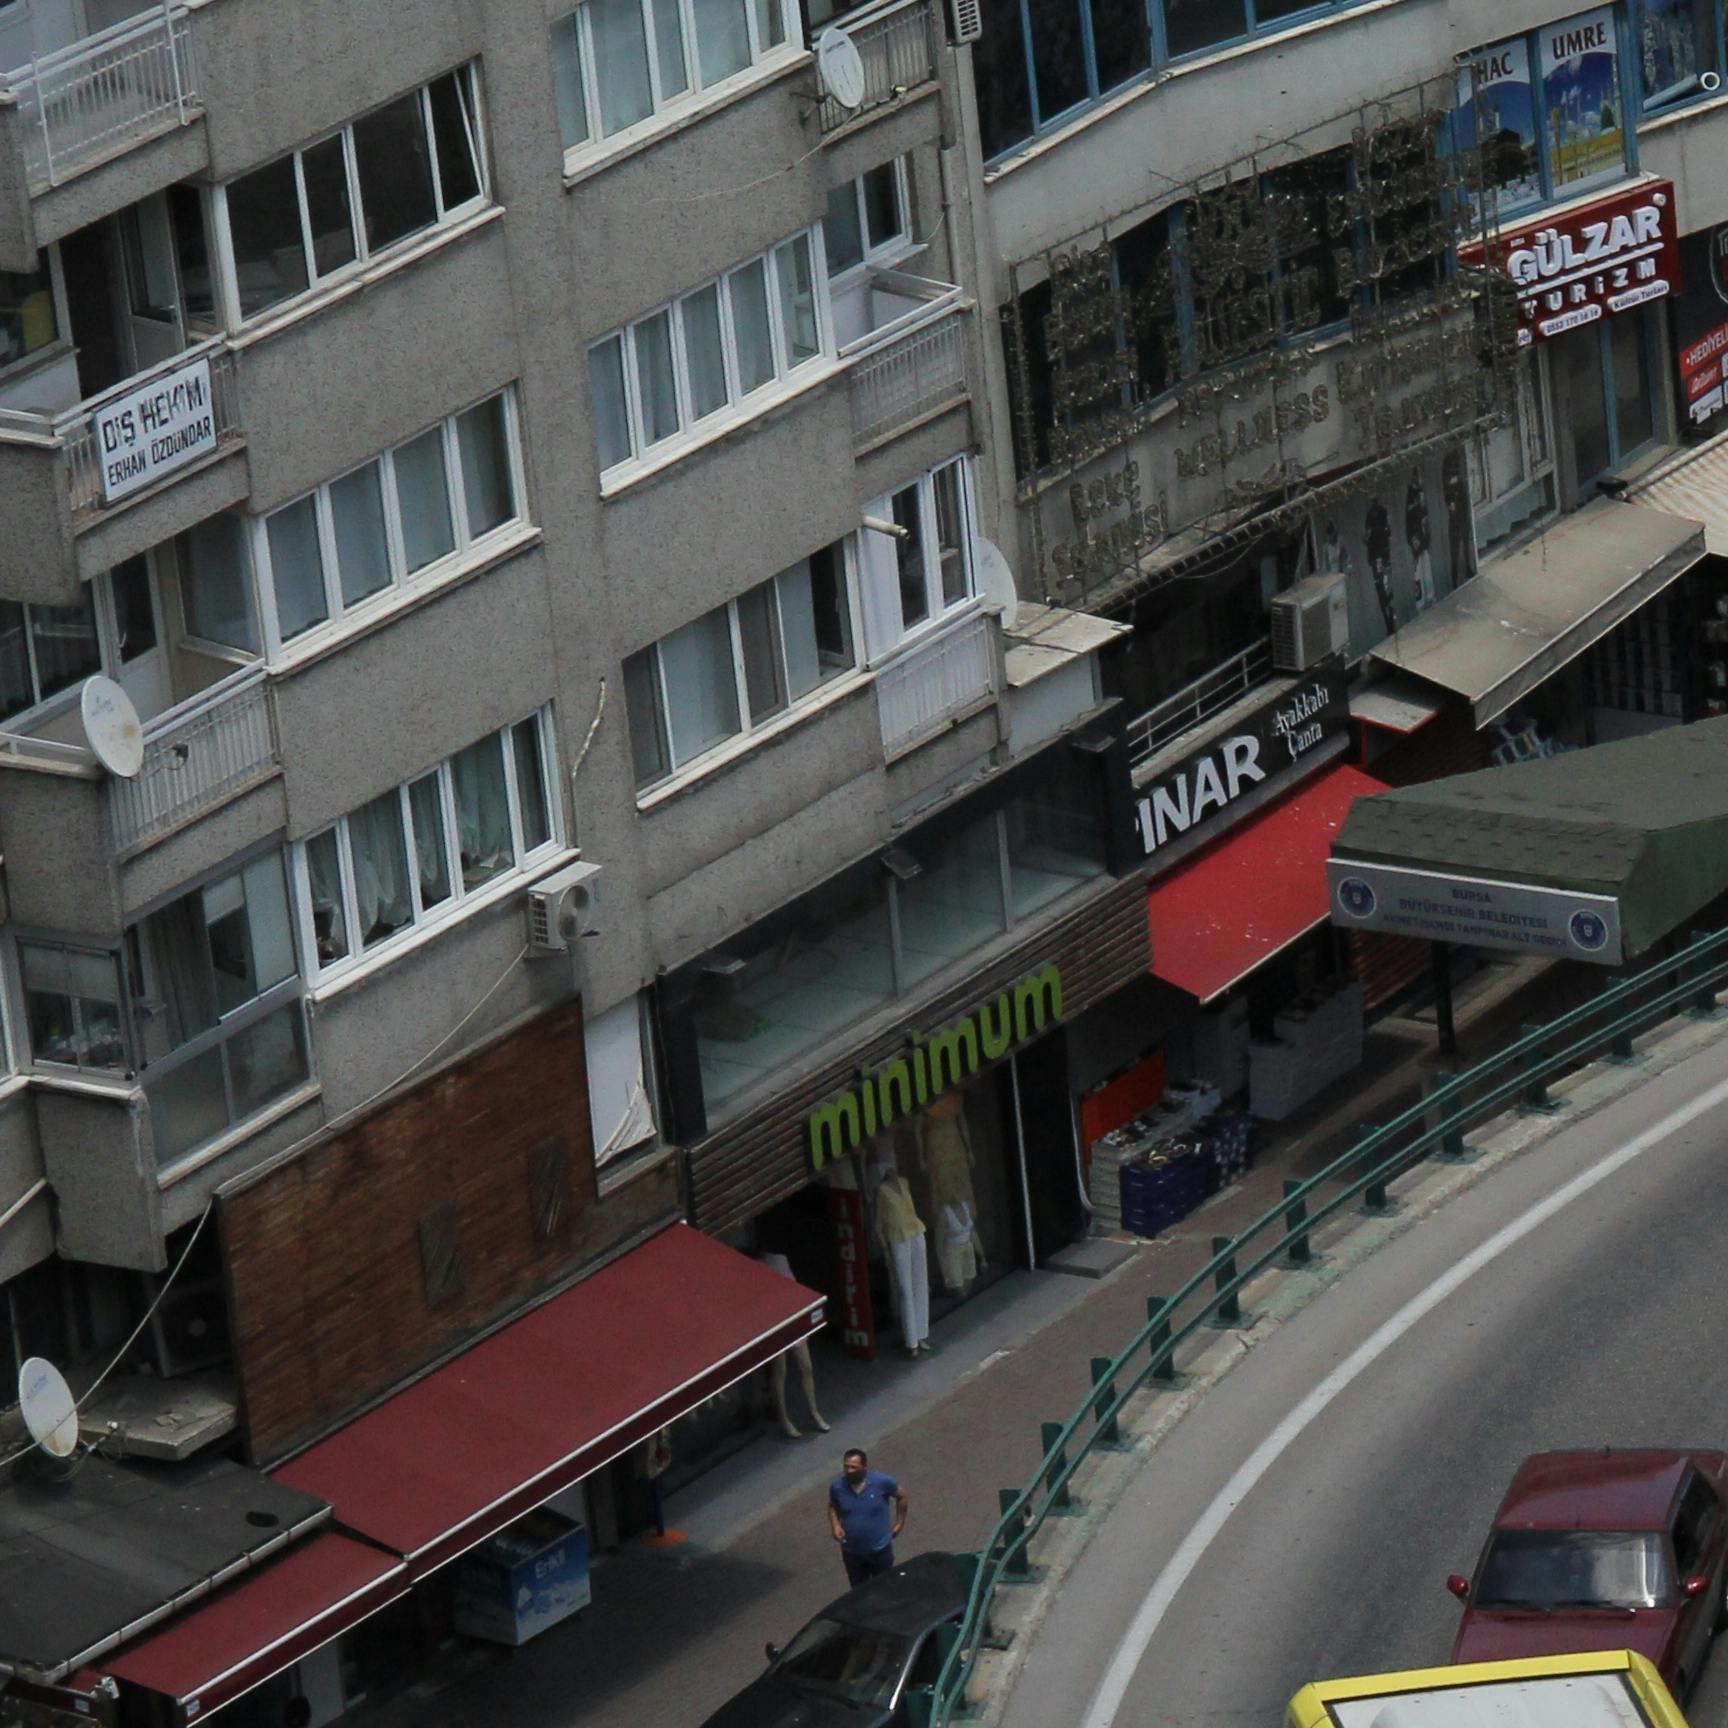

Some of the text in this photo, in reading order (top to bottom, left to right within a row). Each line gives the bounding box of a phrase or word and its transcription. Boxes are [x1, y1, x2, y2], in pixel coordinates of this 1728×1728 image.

[1552, 21, 1607, 60] UMRE
[1475, 52, 1513, 85] HAC
[1507, 205, 1663, 285] GÜLZAR
[102, 409, 136, 454] DİŞ
[107, 416, 212, 487] ERHAN ÖZDÜNDAR
[1287, 722, 1323, 763] Çanta
[1135, 735, 1267, 854] INAR
[1451, 888, 1493, 904] BURSA
[809, 964, 1063, 1171] minimum
